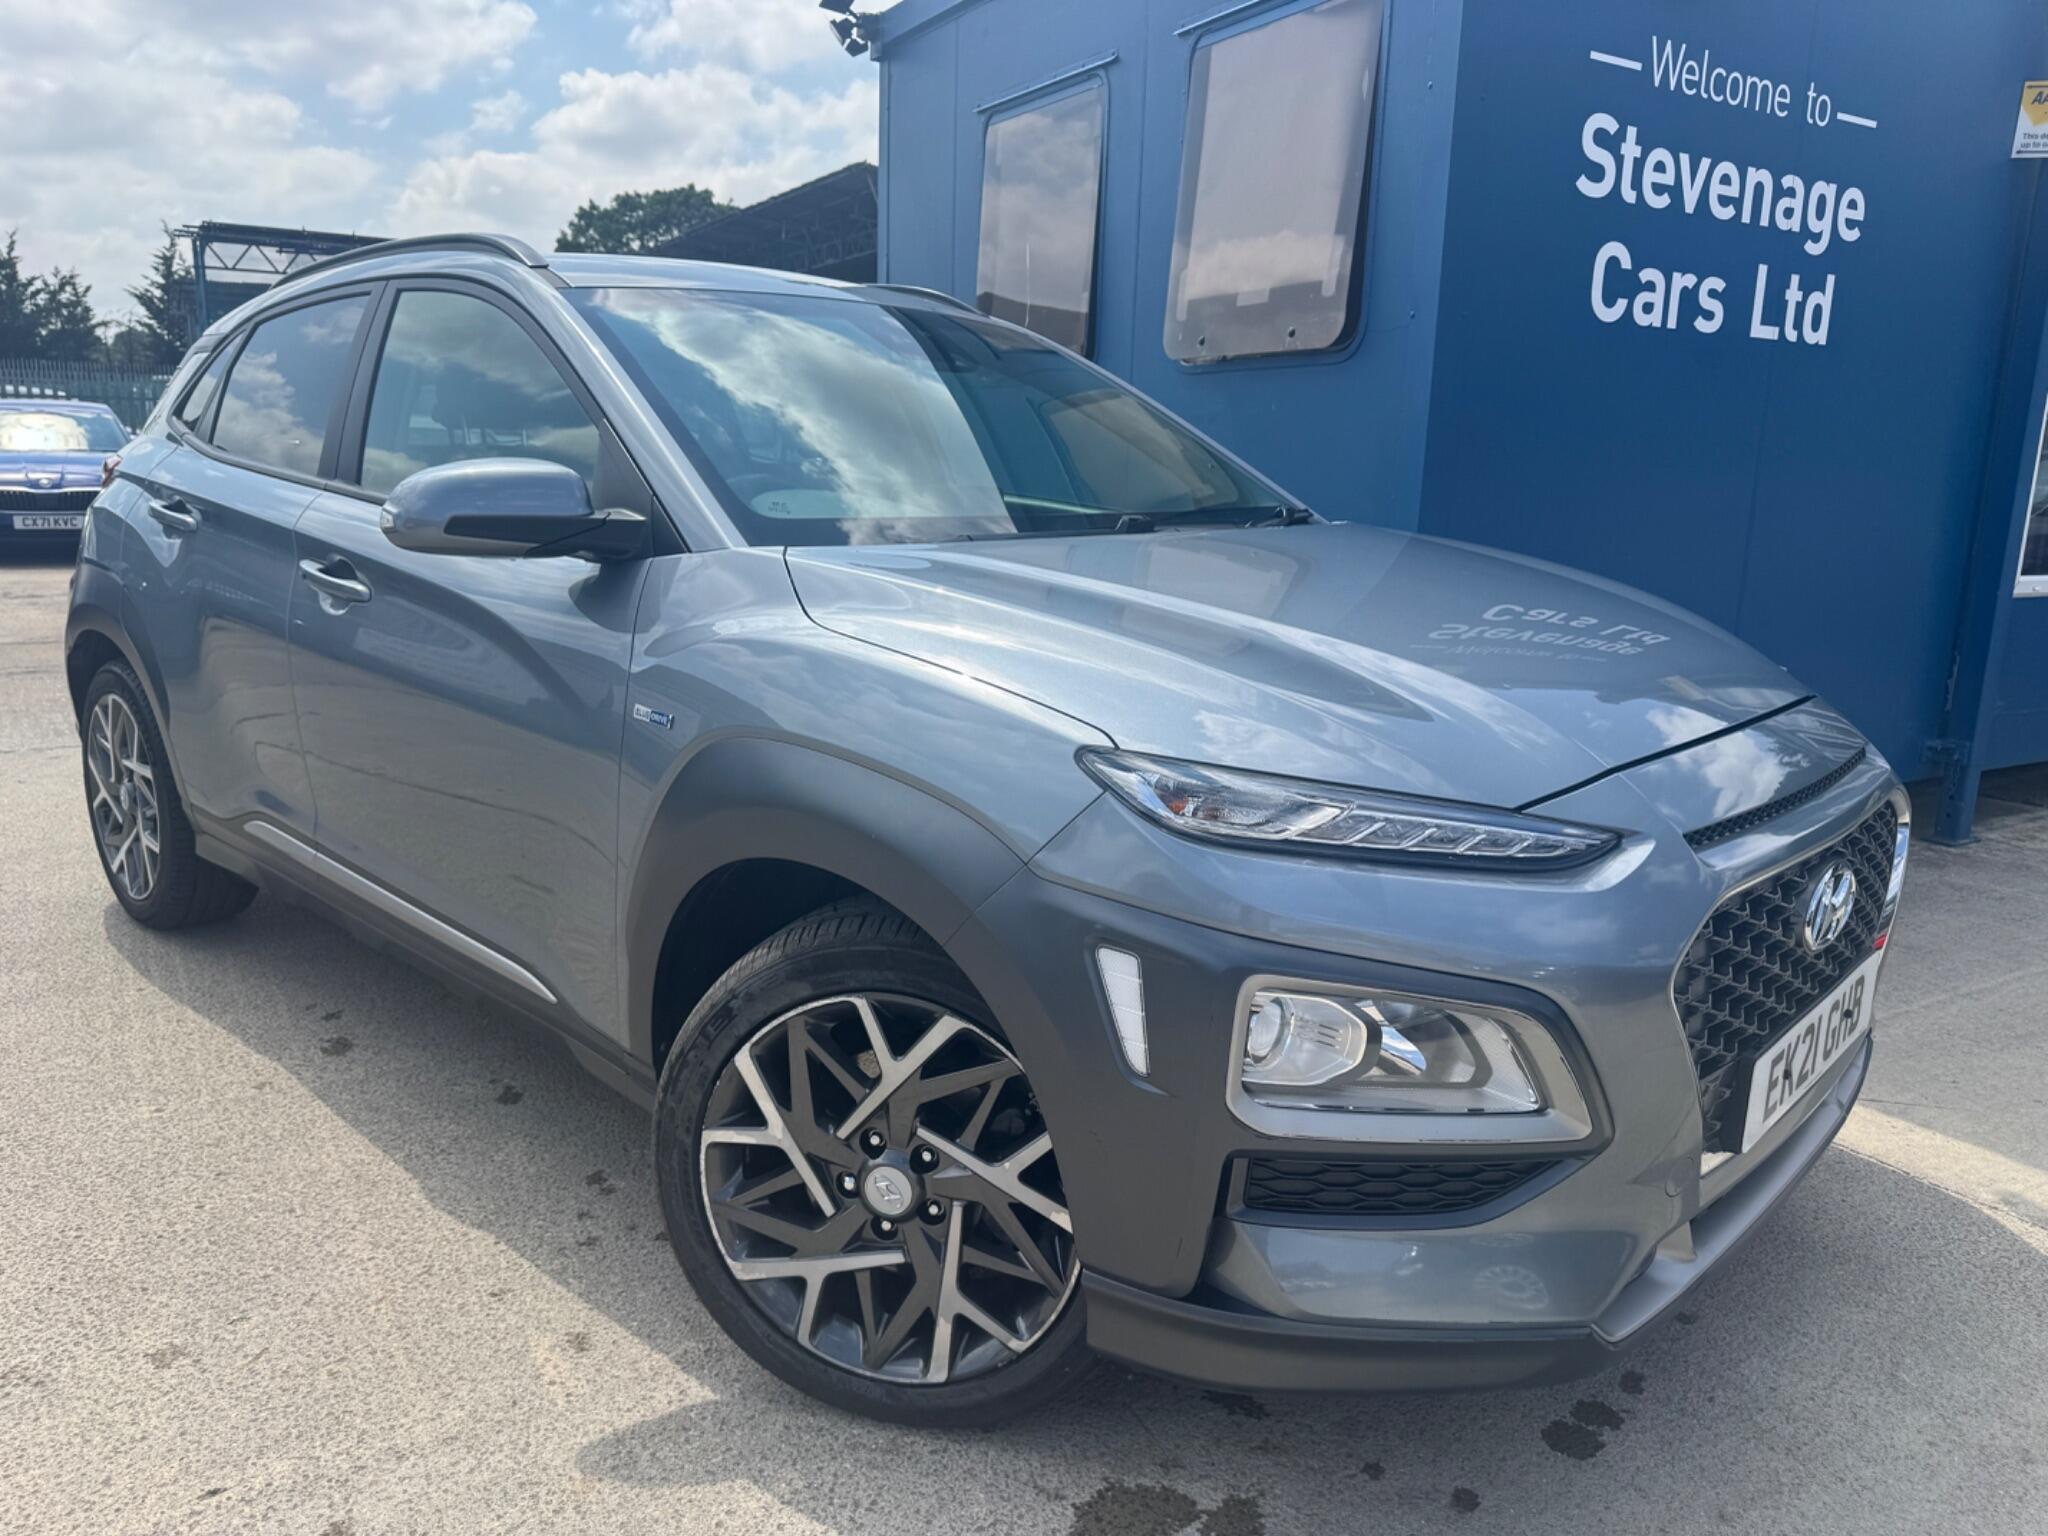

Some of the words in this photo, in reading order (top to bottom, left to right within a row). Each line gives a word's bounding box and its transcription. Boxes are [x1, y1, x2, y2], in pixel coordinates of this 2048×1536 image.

[1651, 35, 1791, 117] Welcome
[1806, 81, 1832, 127] to
[1575, 112, 1866, 256] Stevenage
[1590, 240, 1727, 334] Cars
[1749, 263, 1836, 346] Ltd
[1762, 1009, 1823, 1124] EK21
[1822, 974, 1866, 1059] GHB
